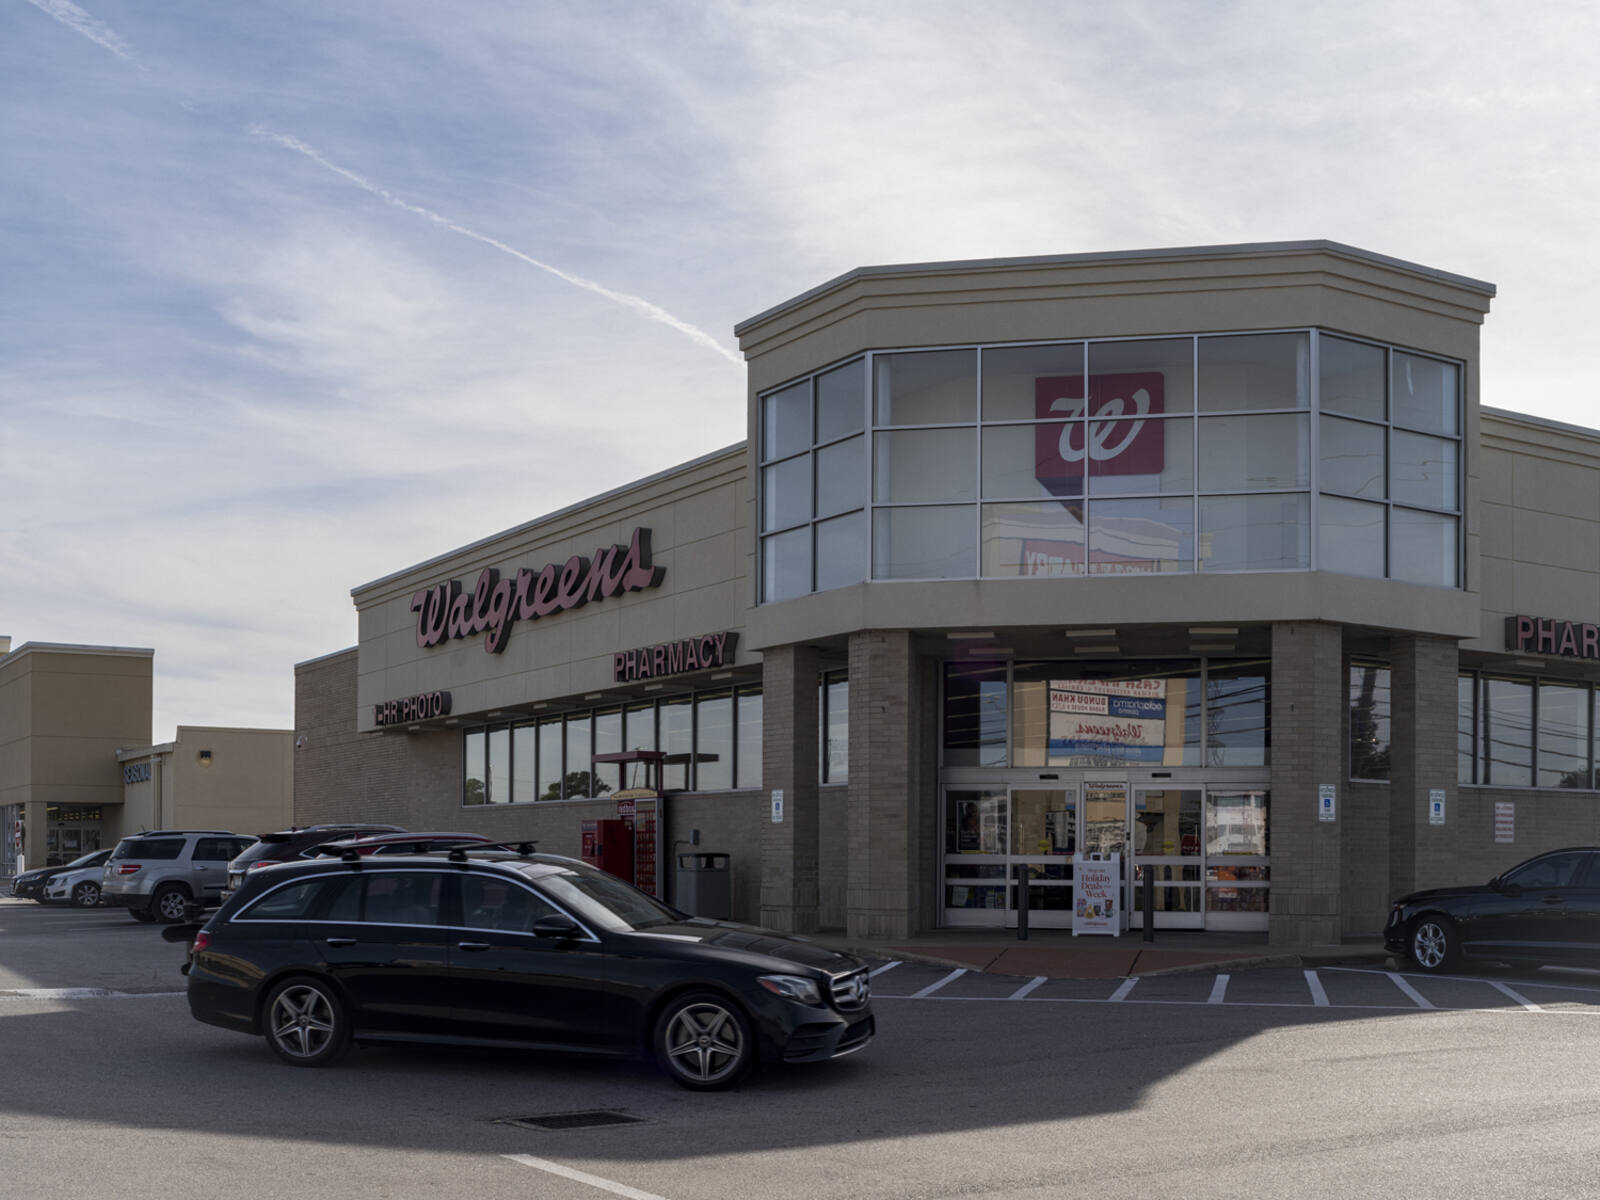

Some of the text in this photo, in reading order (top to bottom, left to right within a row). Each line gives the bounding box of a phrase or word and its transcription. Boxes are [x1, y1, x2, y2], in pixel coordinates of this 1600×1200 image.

[410, 527, 663, 653] Walgreens
[614, 632, 738, 682] PHARMACY
[402, 691, 448, 721] PHOTO
[1081, 873, 1110, 883] Holiday
[1085, 890, 1107, 898] Week
